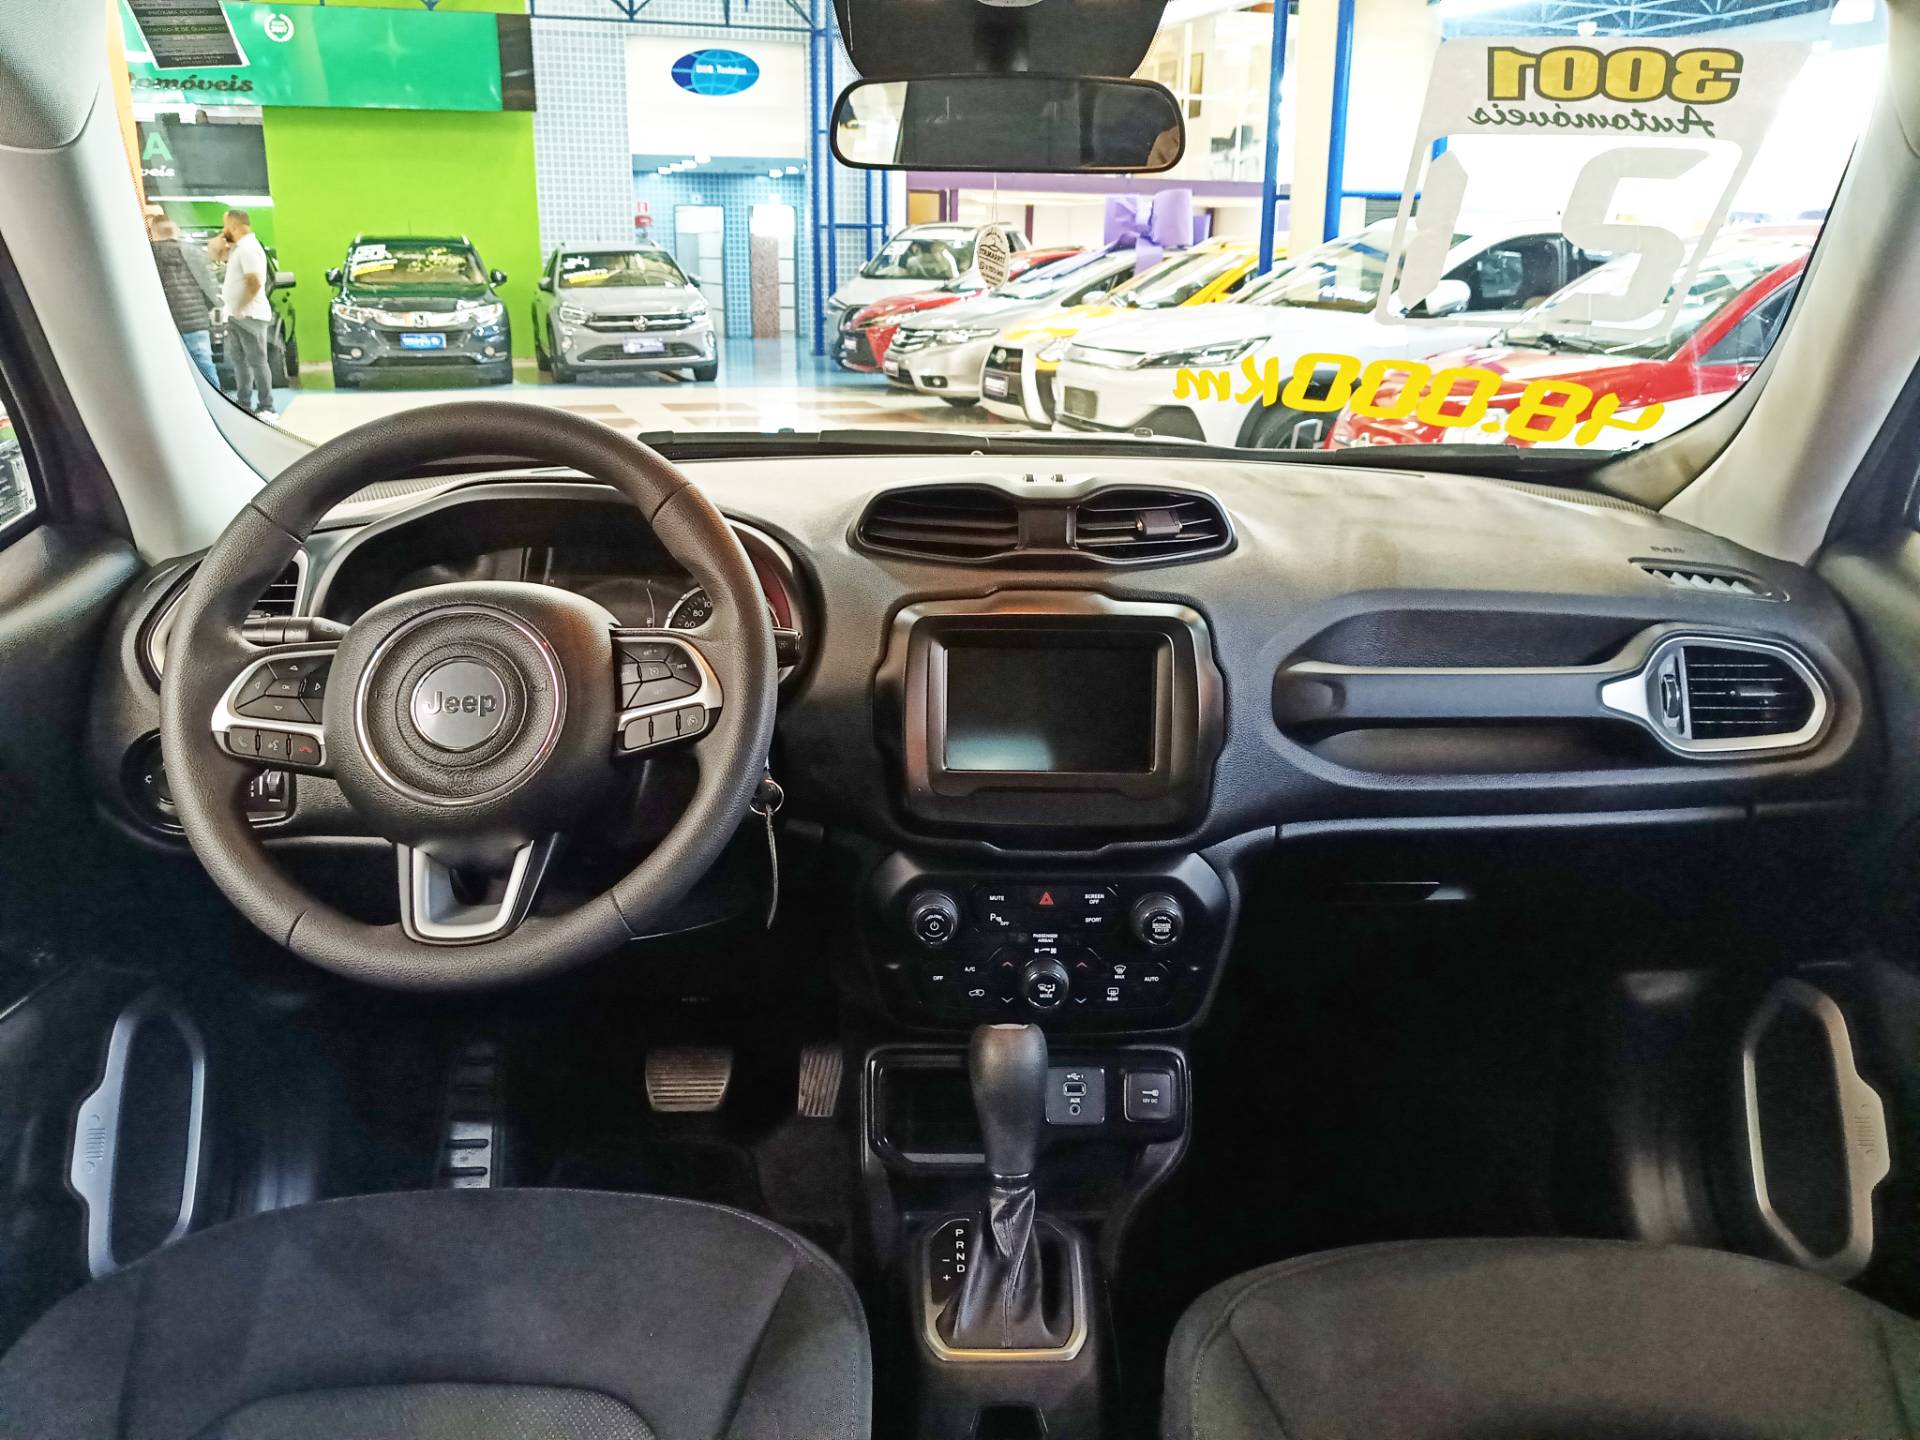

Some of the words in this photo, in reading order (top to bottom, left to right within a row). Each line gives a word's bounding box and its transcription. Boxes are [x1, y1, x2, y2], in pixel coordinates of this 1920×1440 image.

[692, 609, 704, 617] 80
[424, 690, 497, 717] Jeep
[955, 1228, 964, 1237] P
[955, 1240, 965, 1249] R
[956, 1252, 965, 1261] N
[956, 1264, 966, 1273] D
